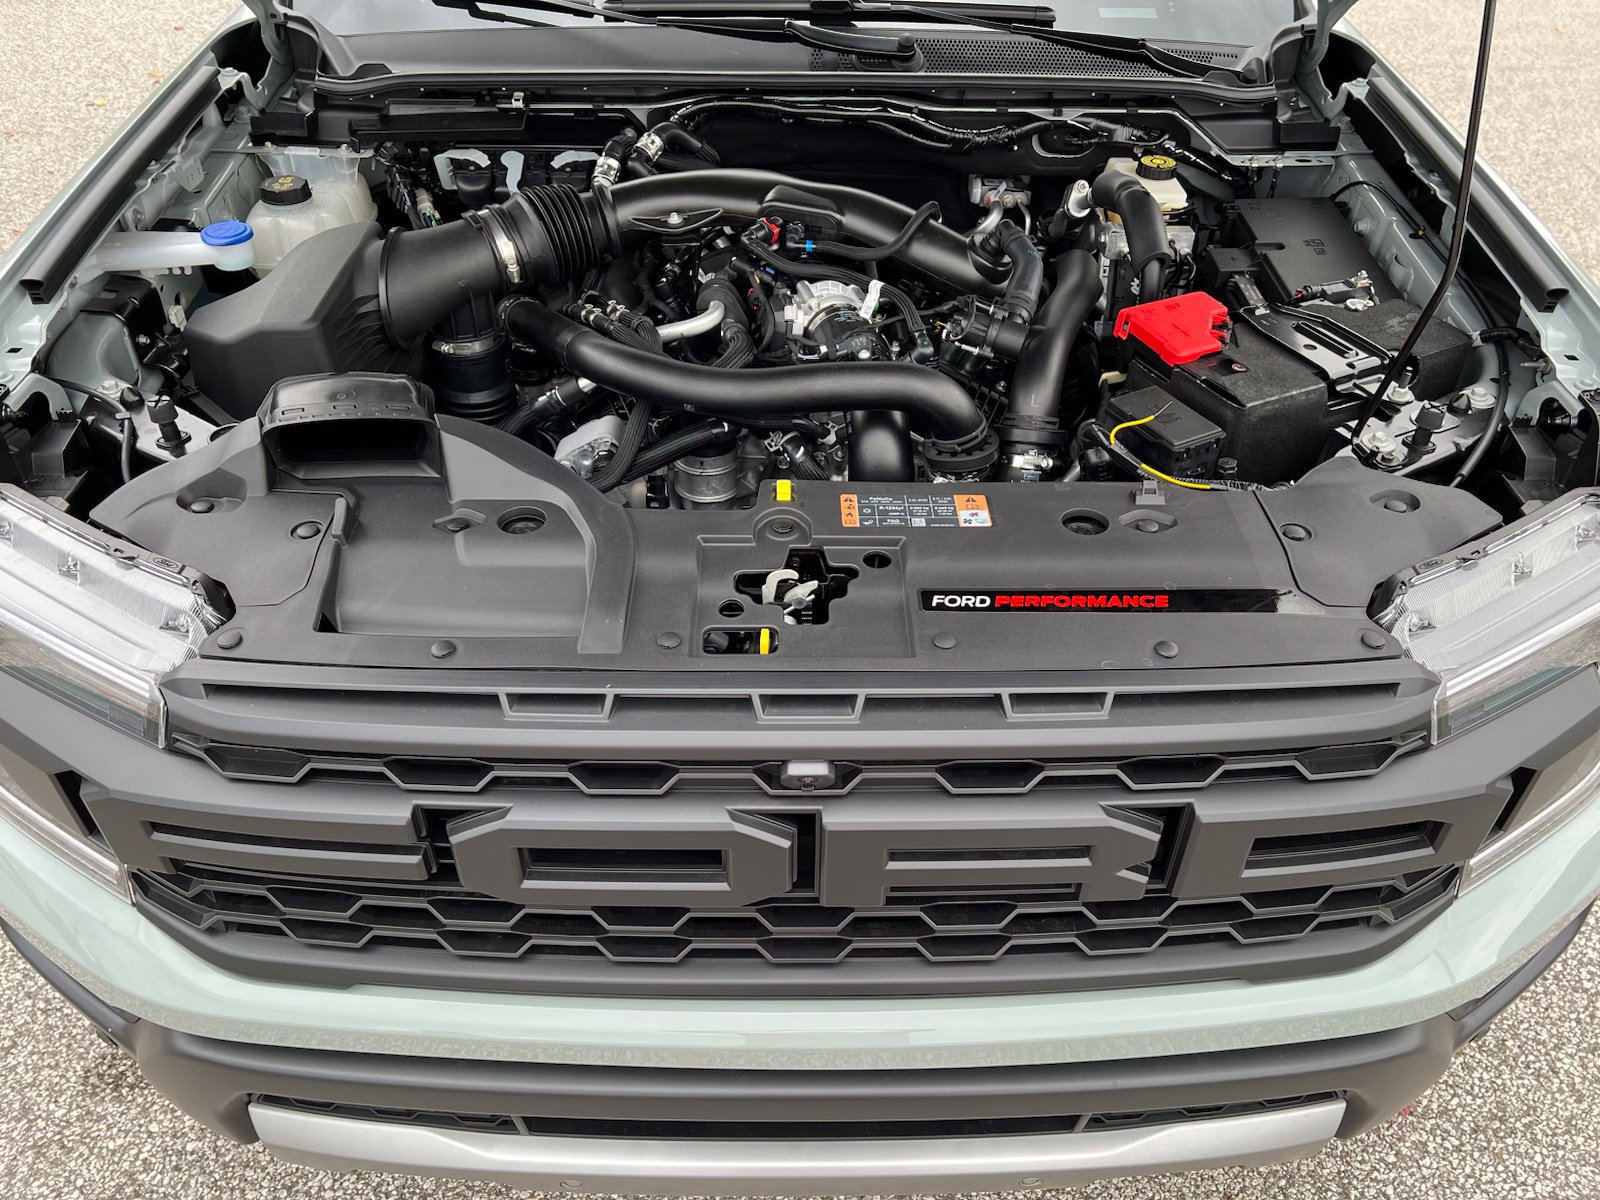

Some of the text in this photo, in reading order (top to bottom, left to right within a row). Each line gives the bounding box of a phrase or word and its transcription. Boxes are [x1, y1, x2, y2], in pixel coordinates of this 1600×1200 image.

[931, 594, 1169, 608] FORD PERFORMANCE
[79, 776, 1515, 907] FORD
